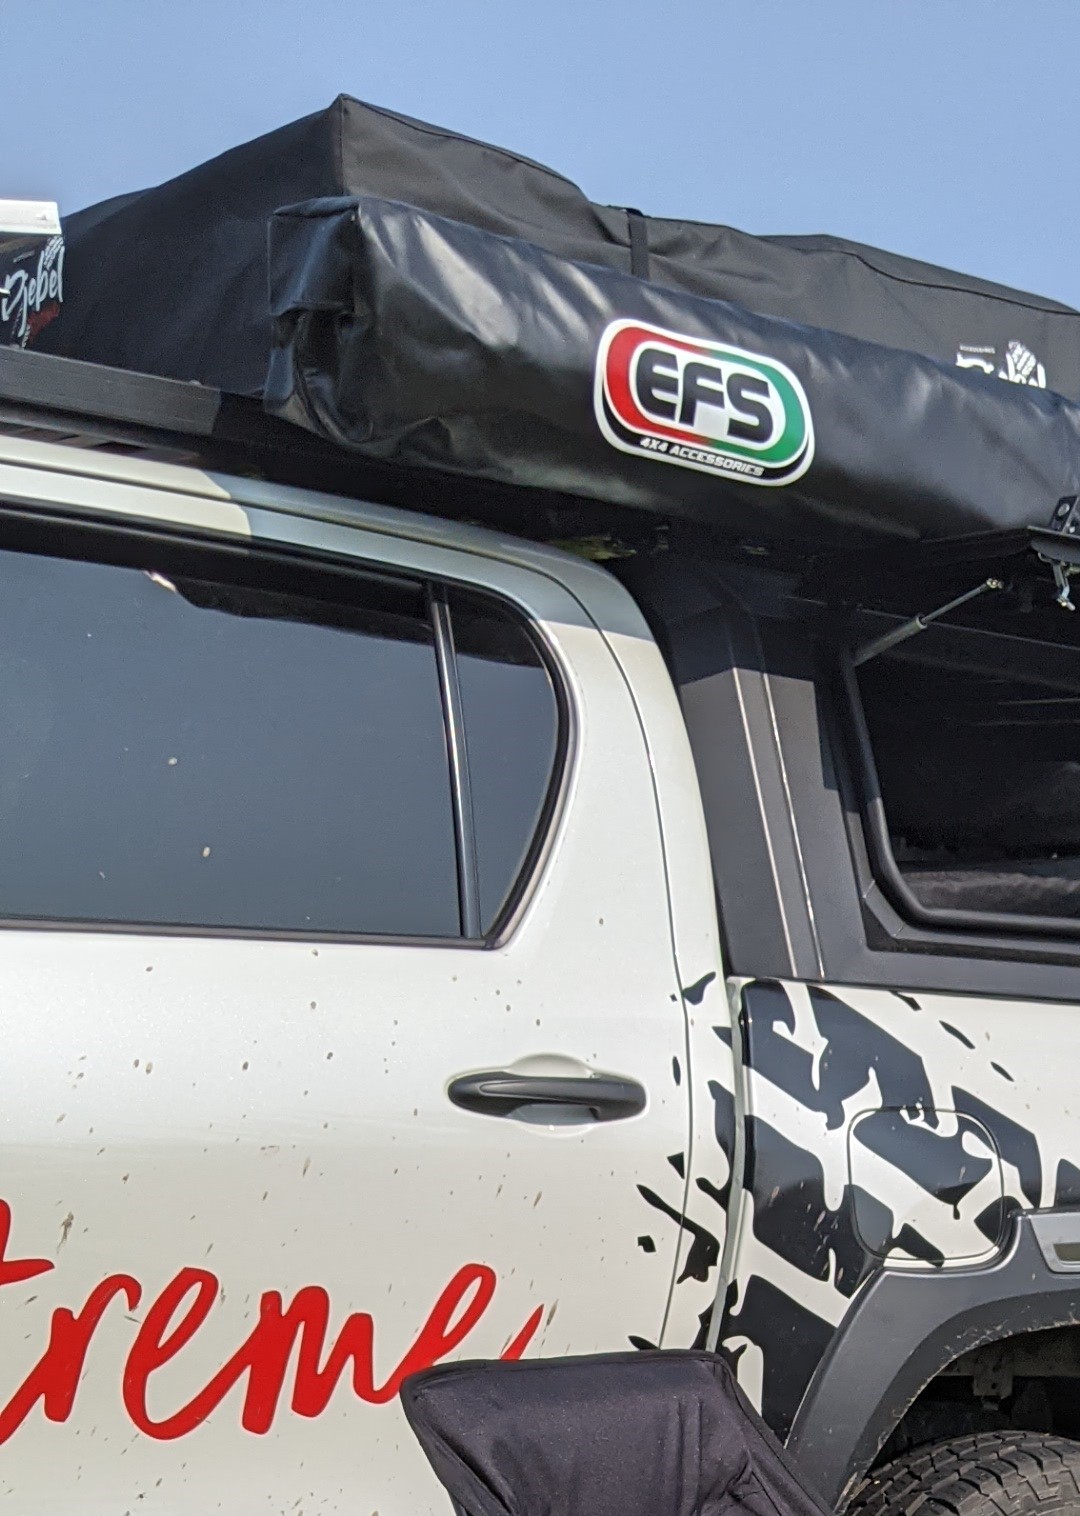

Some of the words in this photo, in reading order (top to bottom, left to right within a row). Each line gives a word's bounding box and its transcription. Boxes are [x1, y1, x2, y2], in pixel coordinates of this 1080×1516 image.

[636, 348, 774, 444] EFS
[640, 437, 669, 453] 4X4
[669, 445, 765, 477] ACCESSORIES
